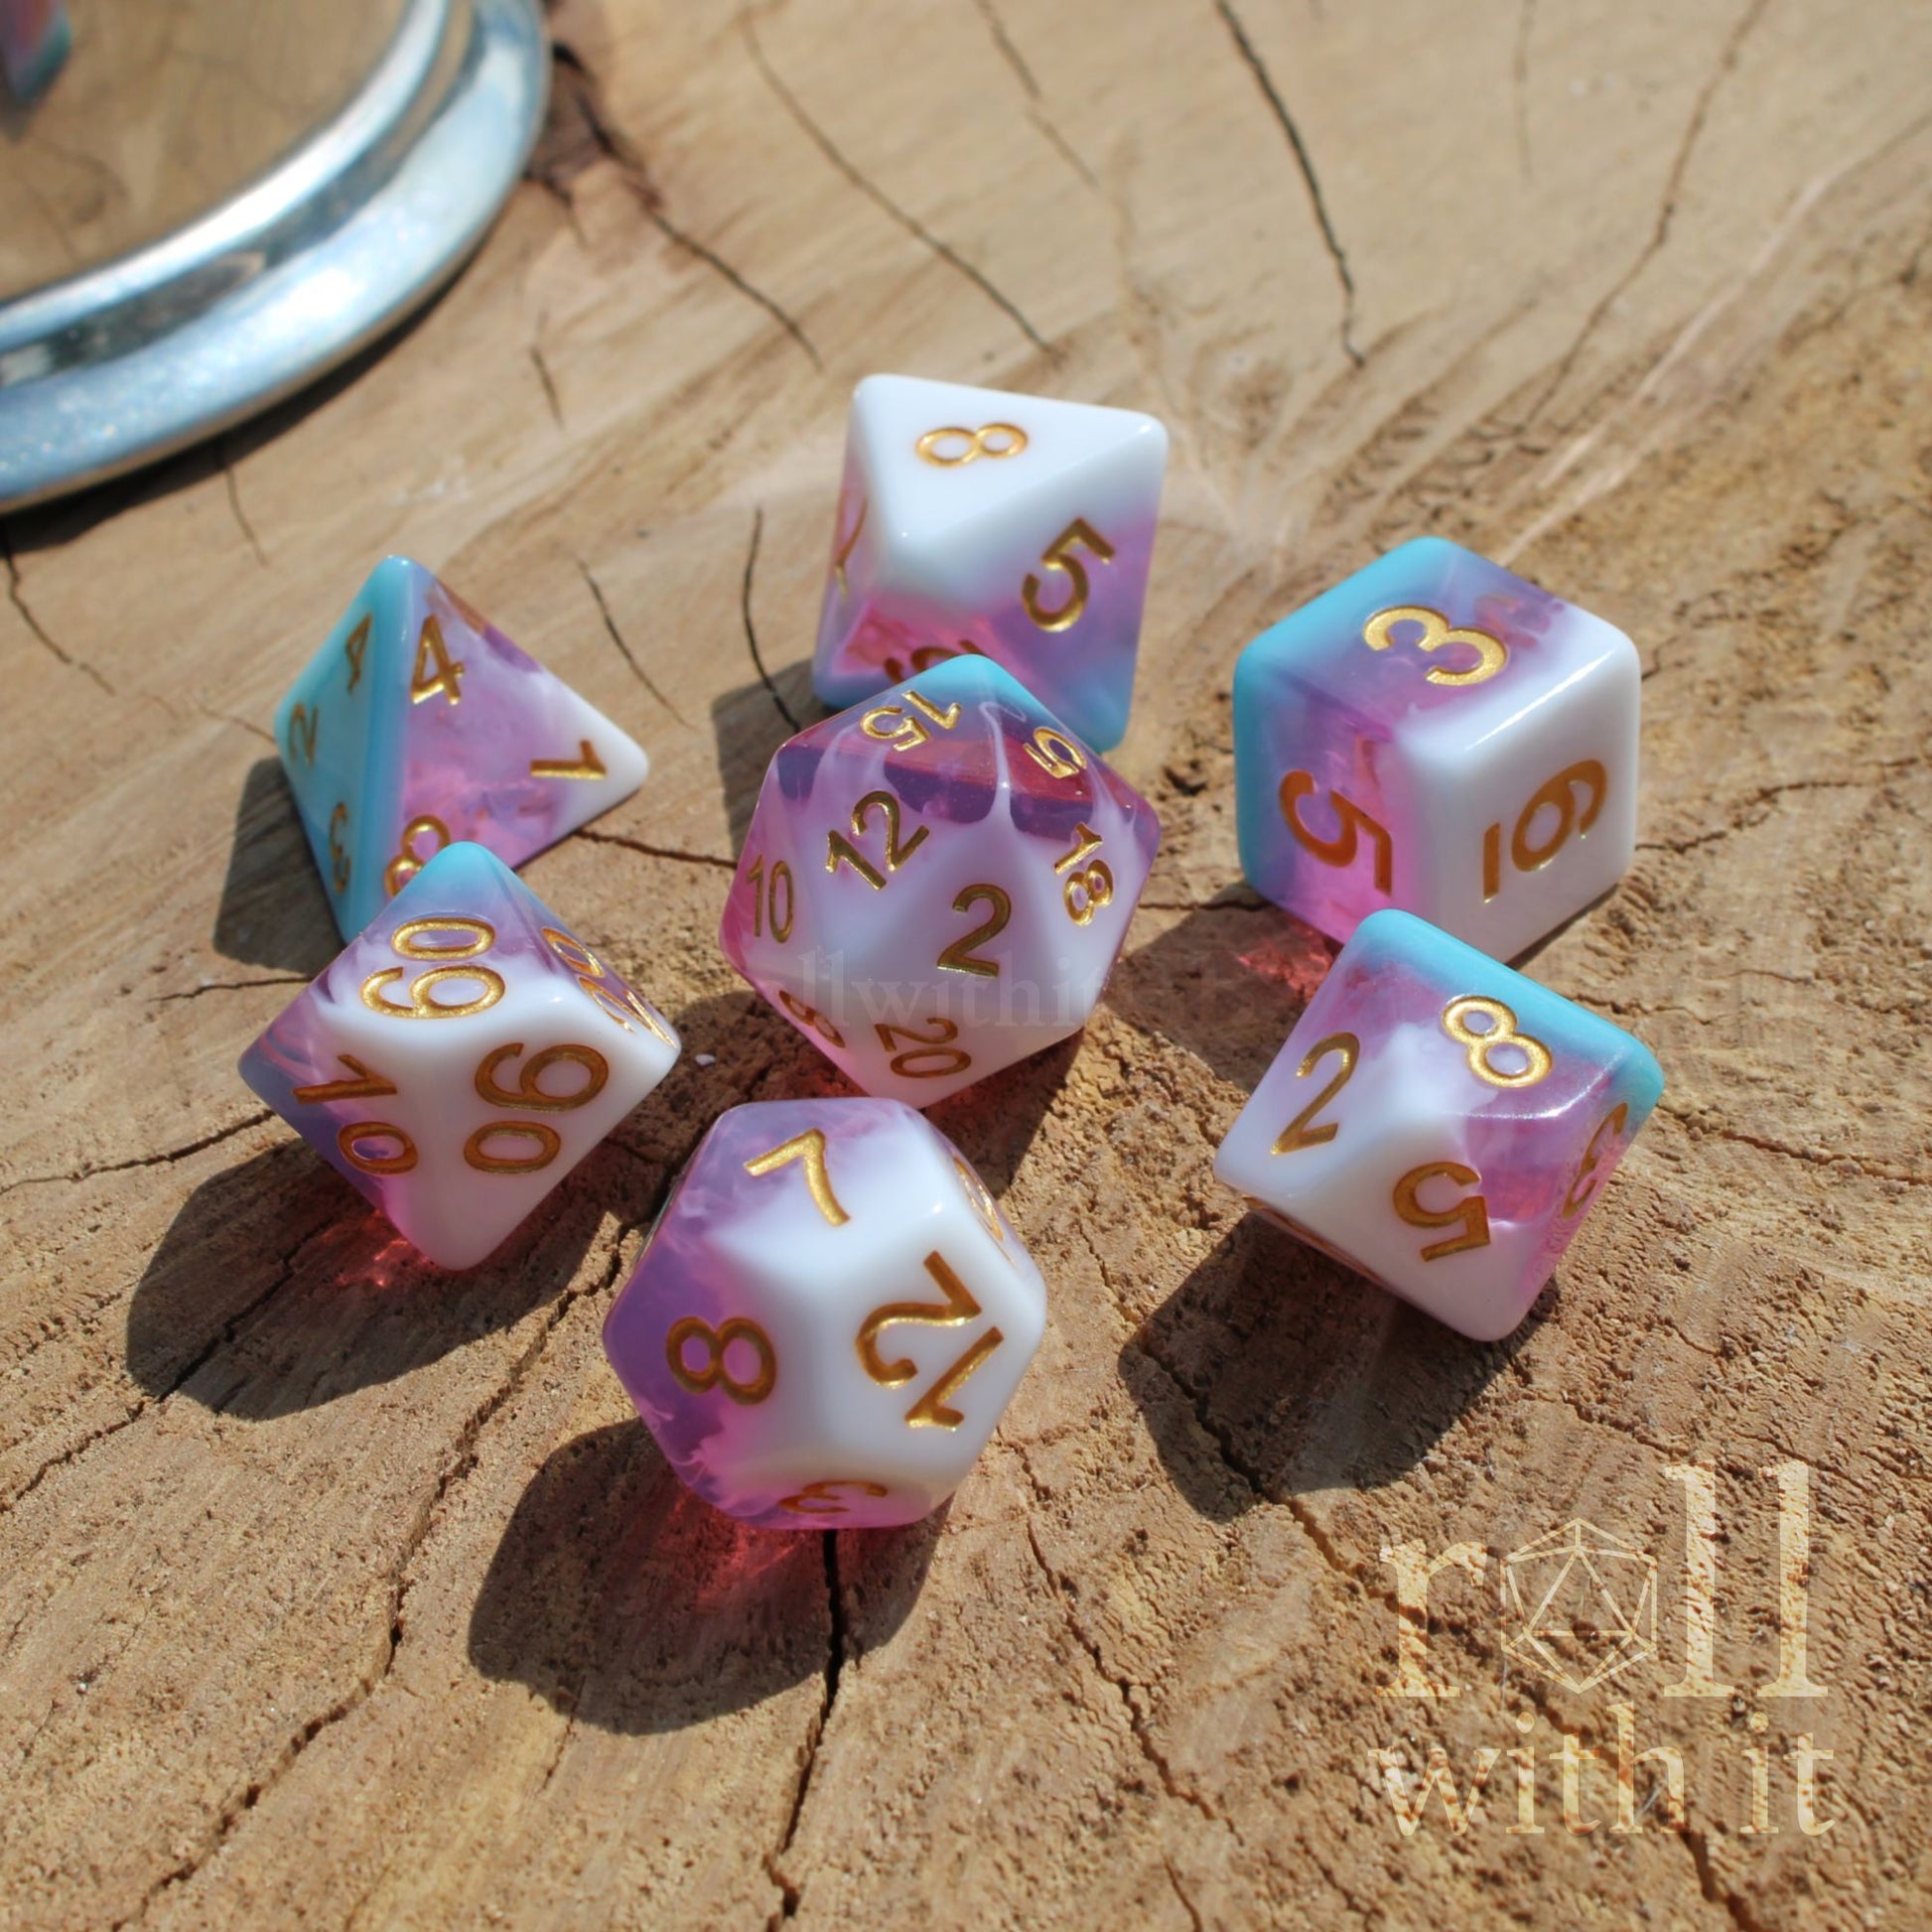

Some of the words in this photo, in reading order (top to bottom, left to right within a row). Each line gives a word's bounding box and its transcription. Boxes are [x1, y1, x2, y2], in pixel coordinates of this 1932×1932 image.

[915, 422, 1029, 468] 8
[1022, 517, 1116, 632] 5
[345, 613, 373, 693] 4
[411, 614, 465, 706] 4
[1364, 605, 1508, 687] 3
[288, 703, 319, 768] 2
[529, 740, 607, 780] 1
[860, 690, 962, 752] 15
[329, 802, 351, 893] 3
[825, 789, 930, 891] 12
[1053, 821, 1114, 927] 18
[1279, 768, 1393, 897] 5
[748, 854, 794, 944] 10
[936, 884, 1012, 977] 2
[875, 1017, 972, 1079] 20
[1441, 995, 1553, 1088] 8
[292, 1054, 418, 1175] 10
[1270, 1032, 1360, 1157] 2
[743, 1127, 851, 1227] 7
[1392, 1162, 1490, 1263] 5
[665, 1315, 776, 1406] 8
[855, 1250, 1004, 1432] 12
